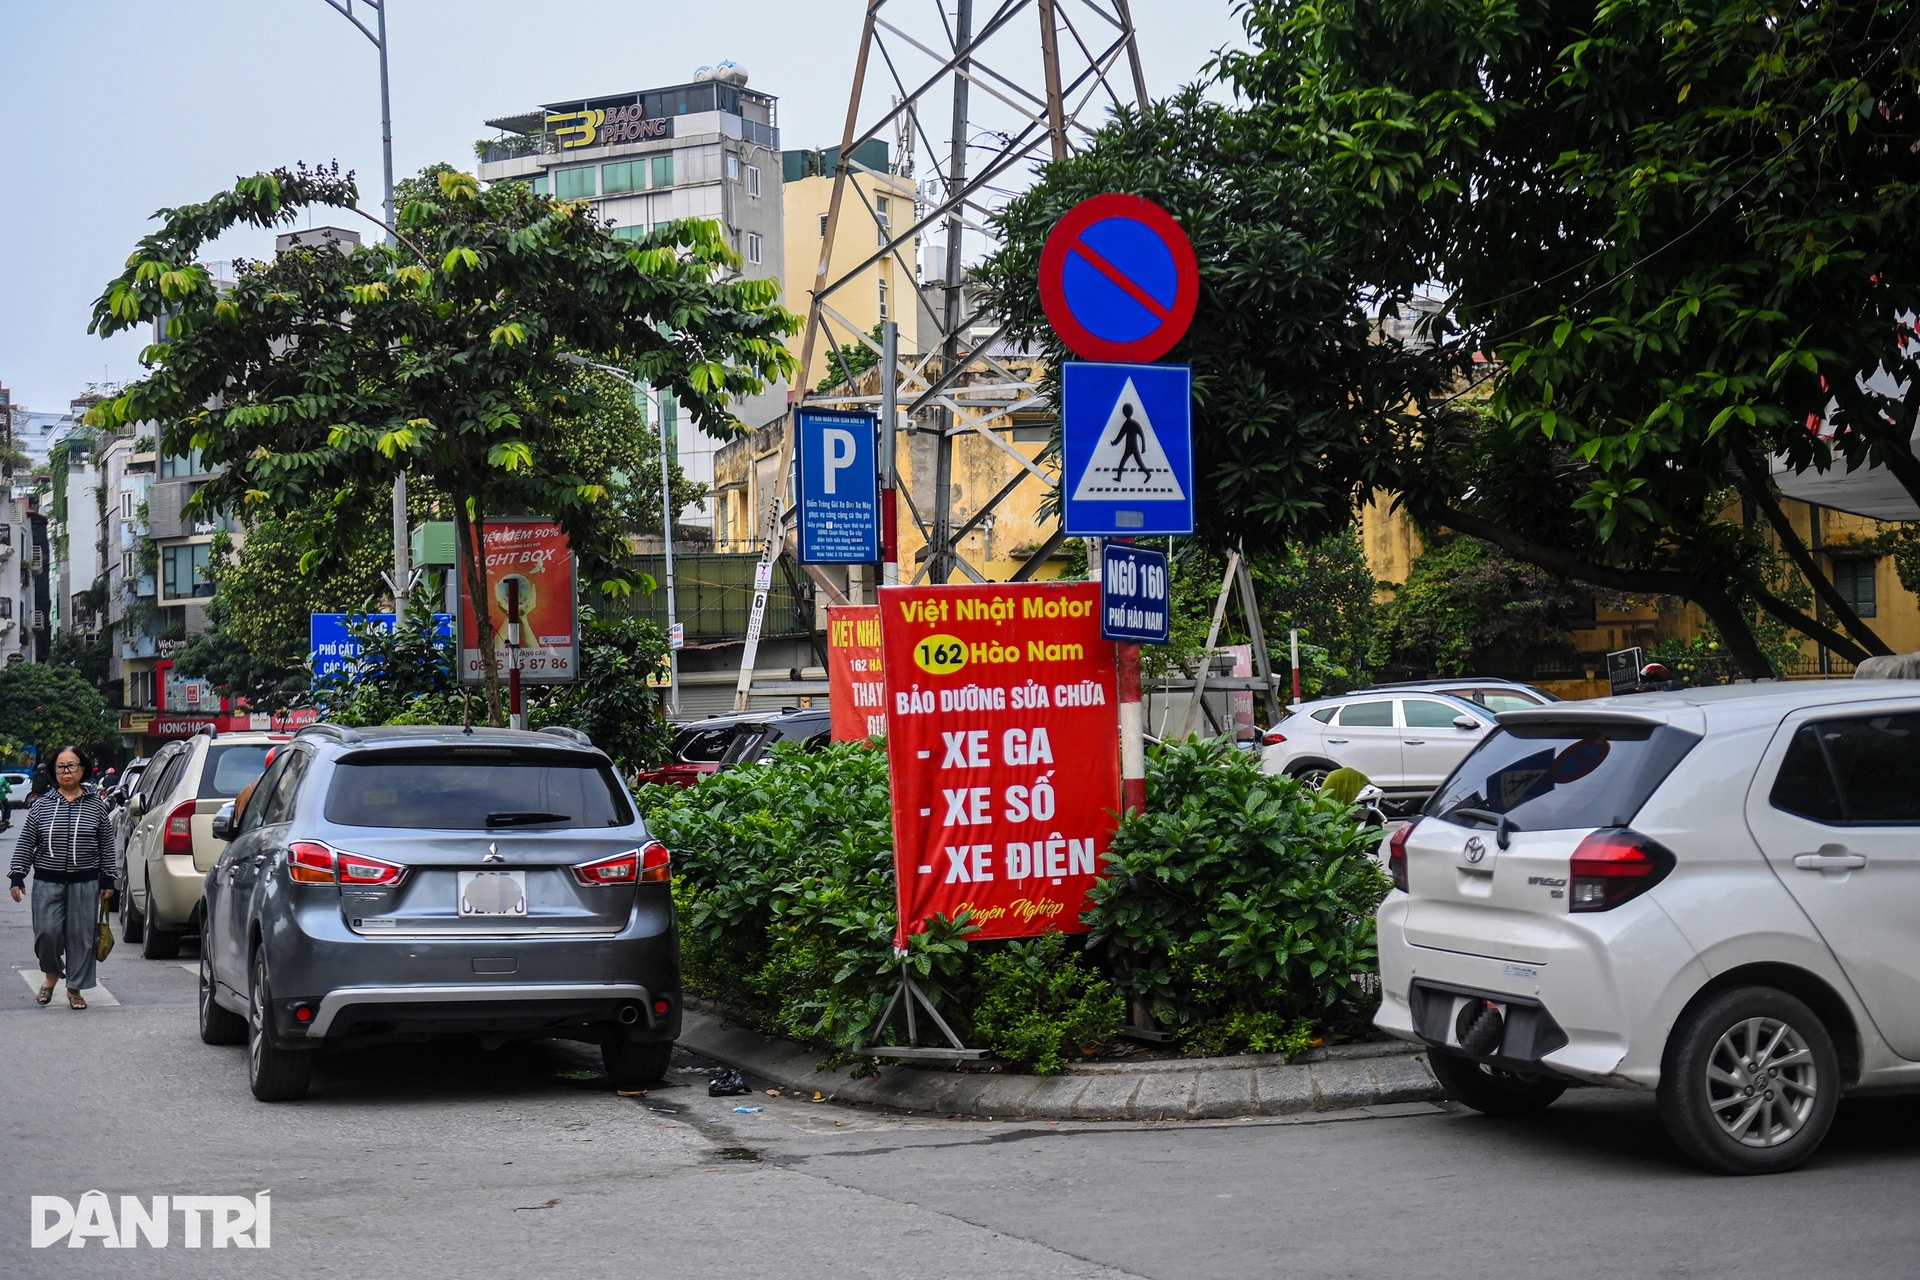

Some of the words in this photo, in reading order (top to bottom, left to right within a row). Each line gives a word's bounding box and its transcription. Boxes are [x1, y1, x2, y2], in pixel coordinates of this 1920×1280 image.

[603, 118, 667, 142] PHONG
[823, 428, 856, 494] P
[535, 527, 560, 539] 90%
[520, 549, 556, 563] BOX
[1108, 554, 1137, 597] NGÕ
[1140, 564, 1164, 600] 160
[755, 594, 764, 608] 6
[900, 598, 949, 628] Việt
[956, 596, 1015, 627] Nhật
[1023, 596, 1093, 619] Motor
[1109, 602, 1126, 627] PHỐ
[1127, 605, 1144, 629] HÀO
[1145, 611, 1163, 631] NAM
[319, 640, 336, 656] PHỐ
[339, 642, 354, 656] CÁT
[920, 643, 964, 666] 162
[970, 639, 1021, 665] Hào
[1028, 640, 1084, 662] Nam
[324, 660, 340, 674] CÁC
[470, 660, 504, 671] 085
[530, 658, 546, 669] 87
[552, 658, 568, 669] 86
[850, 659, 867, 672] 162
[852, 682, 884, 707] THAY
[896, 683, 936, 715] BẢO
[940, 683, 1006, 712] DƯỠNG
[1011, 679, 1050, 710] SỬA
[1055, 680, 1106, 708] CHỮA
[941, 729, 991, 769] XE
[1003, 727, 1054, 766] GA
[942, 787, 992, 827] XE
[1005, 769, 1056, 823] SỐ
[944, 844, 994, 884] XE
[1006, 831, 1096, 886] ĐIỆN
[1010, 896, 1064, 924] Nghiệp
